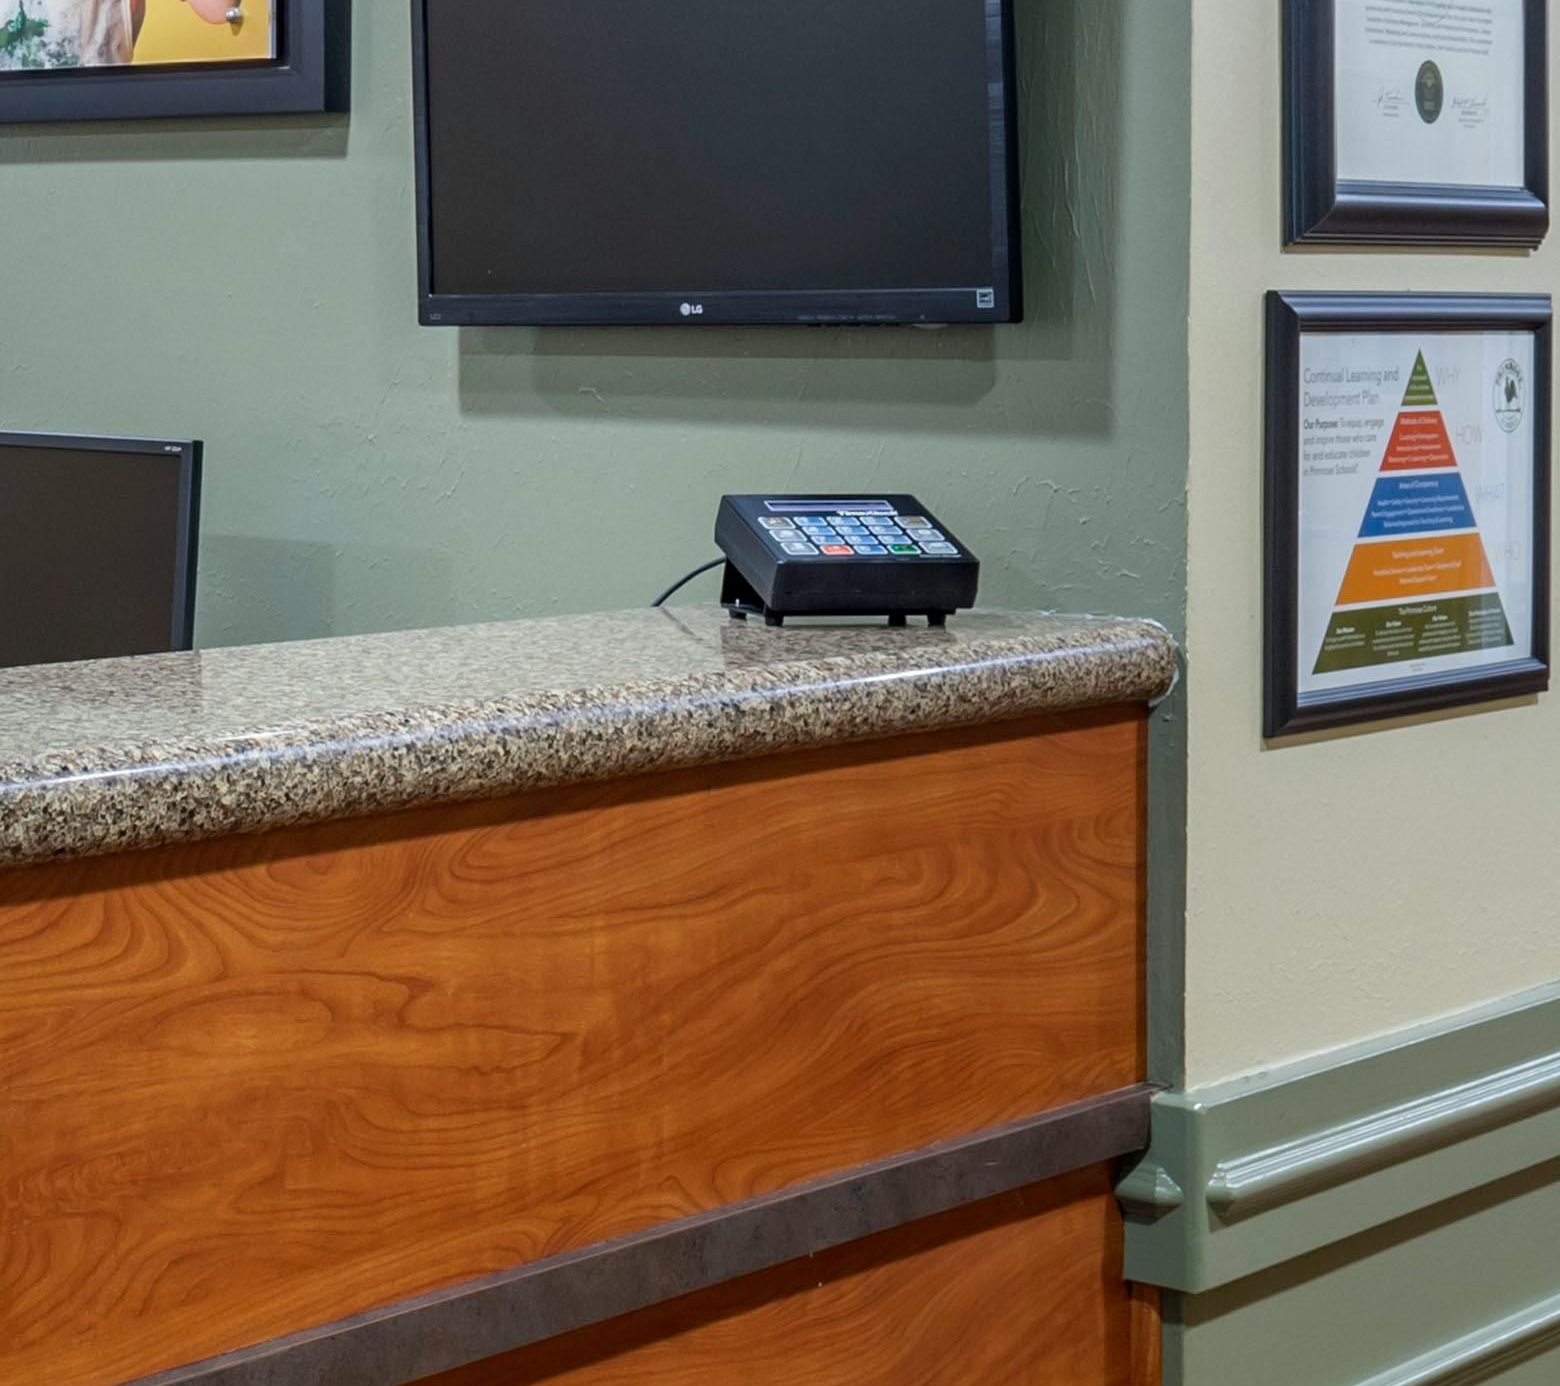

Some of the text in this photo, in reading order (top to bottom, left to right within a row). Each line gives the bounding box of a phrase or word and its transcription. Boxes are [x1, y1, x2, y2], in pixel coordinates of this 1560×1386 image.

[691, 304, 703, 314] LG
[1303, 367, 1344, 384] Continual
[1346, 367, 1382, 387] Learning
[1383, 365, 1400, 382] and
[1436, 366, 1461, 385] WHY
[1303, 389, 1380, 409] Development Plan
[1455, 424, 1483, 445] HOW
[1475, 482, 1505, 503] WHAT
[1493, 541, 1521, 561] WHO
